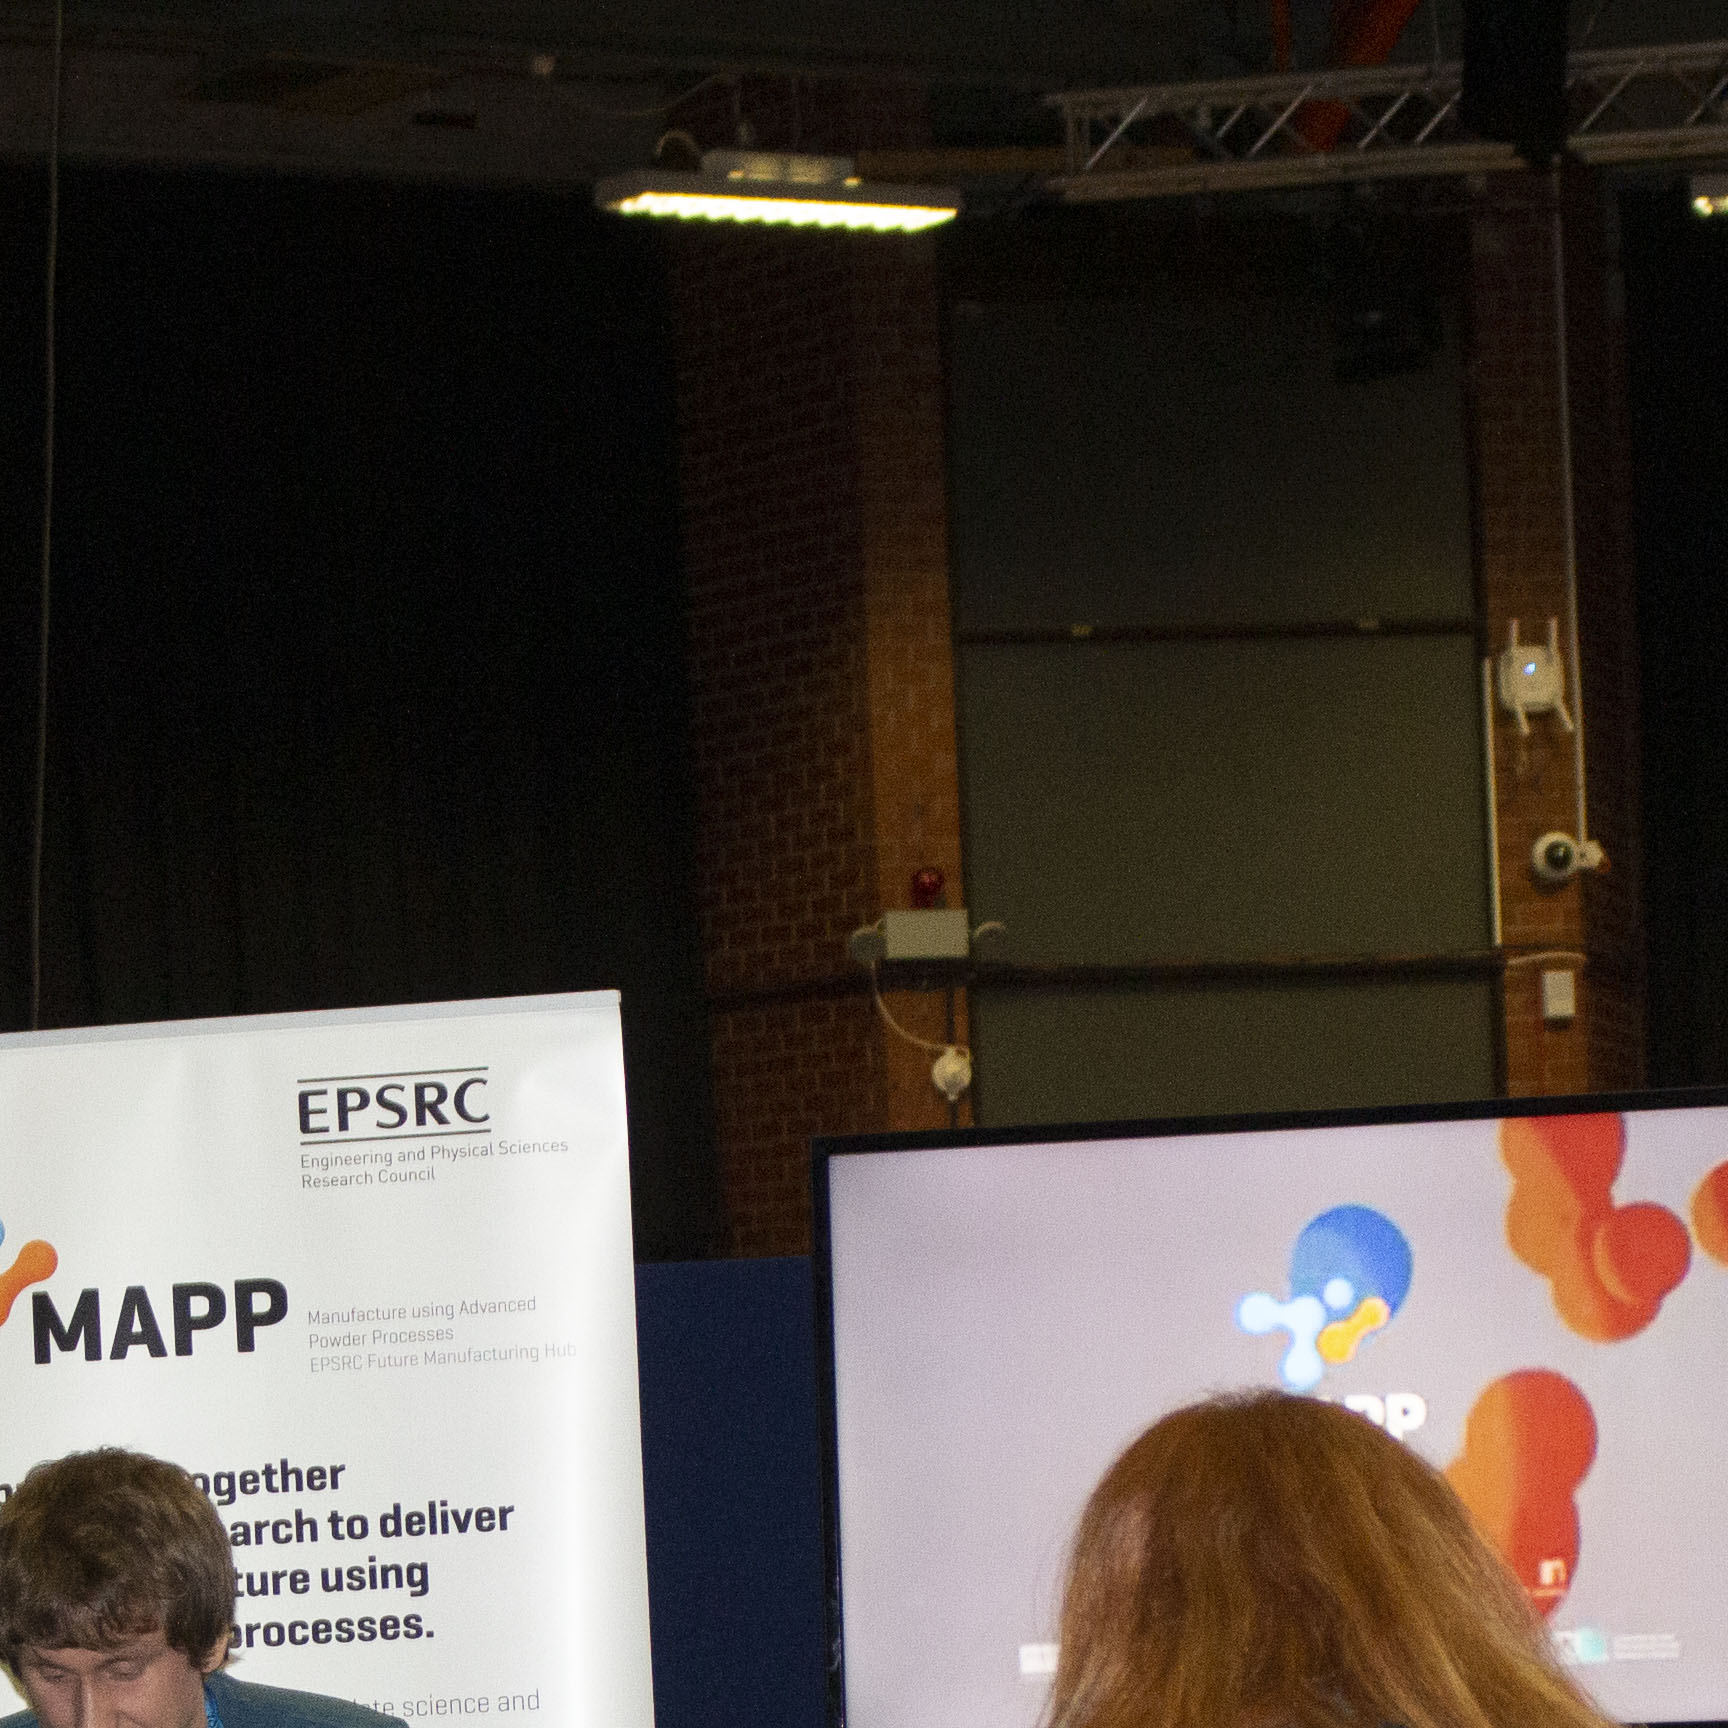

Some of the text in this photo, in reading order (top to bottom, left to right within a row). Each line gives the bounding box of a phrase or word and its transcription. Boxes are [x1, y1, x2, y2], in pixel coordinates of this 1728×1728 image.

[298, 1077, 490, 1134] EPSRC
[301, 1139, 568, 1171] Engineering and Physical Sciences
[301, 1167, 435, 1189] Research Council
[32, 1277, 289, 1364] MAPP
[307, 1296, 536, 1325] Manufacture using Advanced
[309, 1326, 454, 1349] Powder Processes
[310, 1342, 576, 1373] EPSRC Future Manufacturing Hub
[328, 1510, 369, 1540] to
[379, 1500, 514, 1538] deliver
[321, 1555, 429, 1597] using
[403, 1694, 490, 1717] science
[498, 1688, 540, 1712] and
